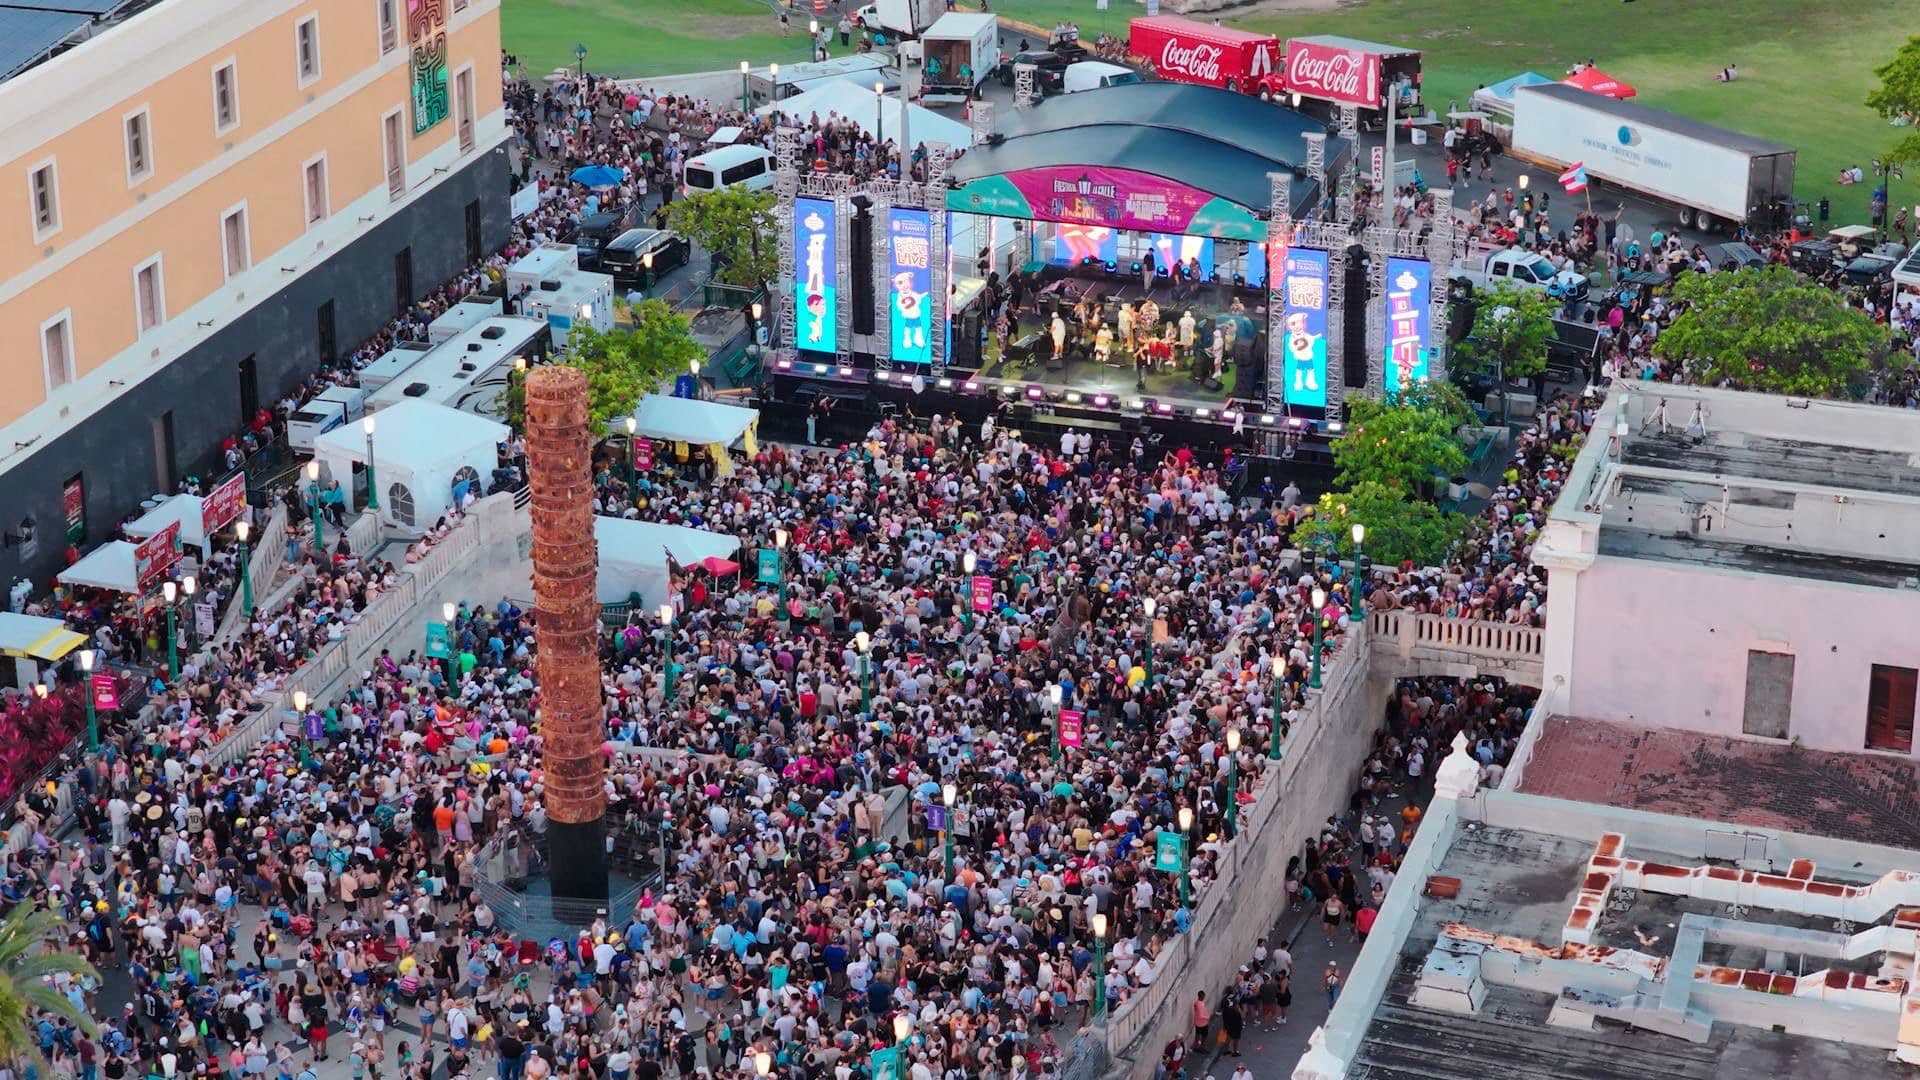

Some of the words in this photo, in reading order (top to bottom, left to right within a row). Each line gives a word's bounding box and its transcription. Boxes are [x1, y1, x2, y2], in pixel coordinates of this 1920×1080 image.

[1162, 38, 1224, 80] Coca-Cola
[1291, 48, 1361, 95] Coca-Cola
[1374, 148, 1382, 184] PARKIN
